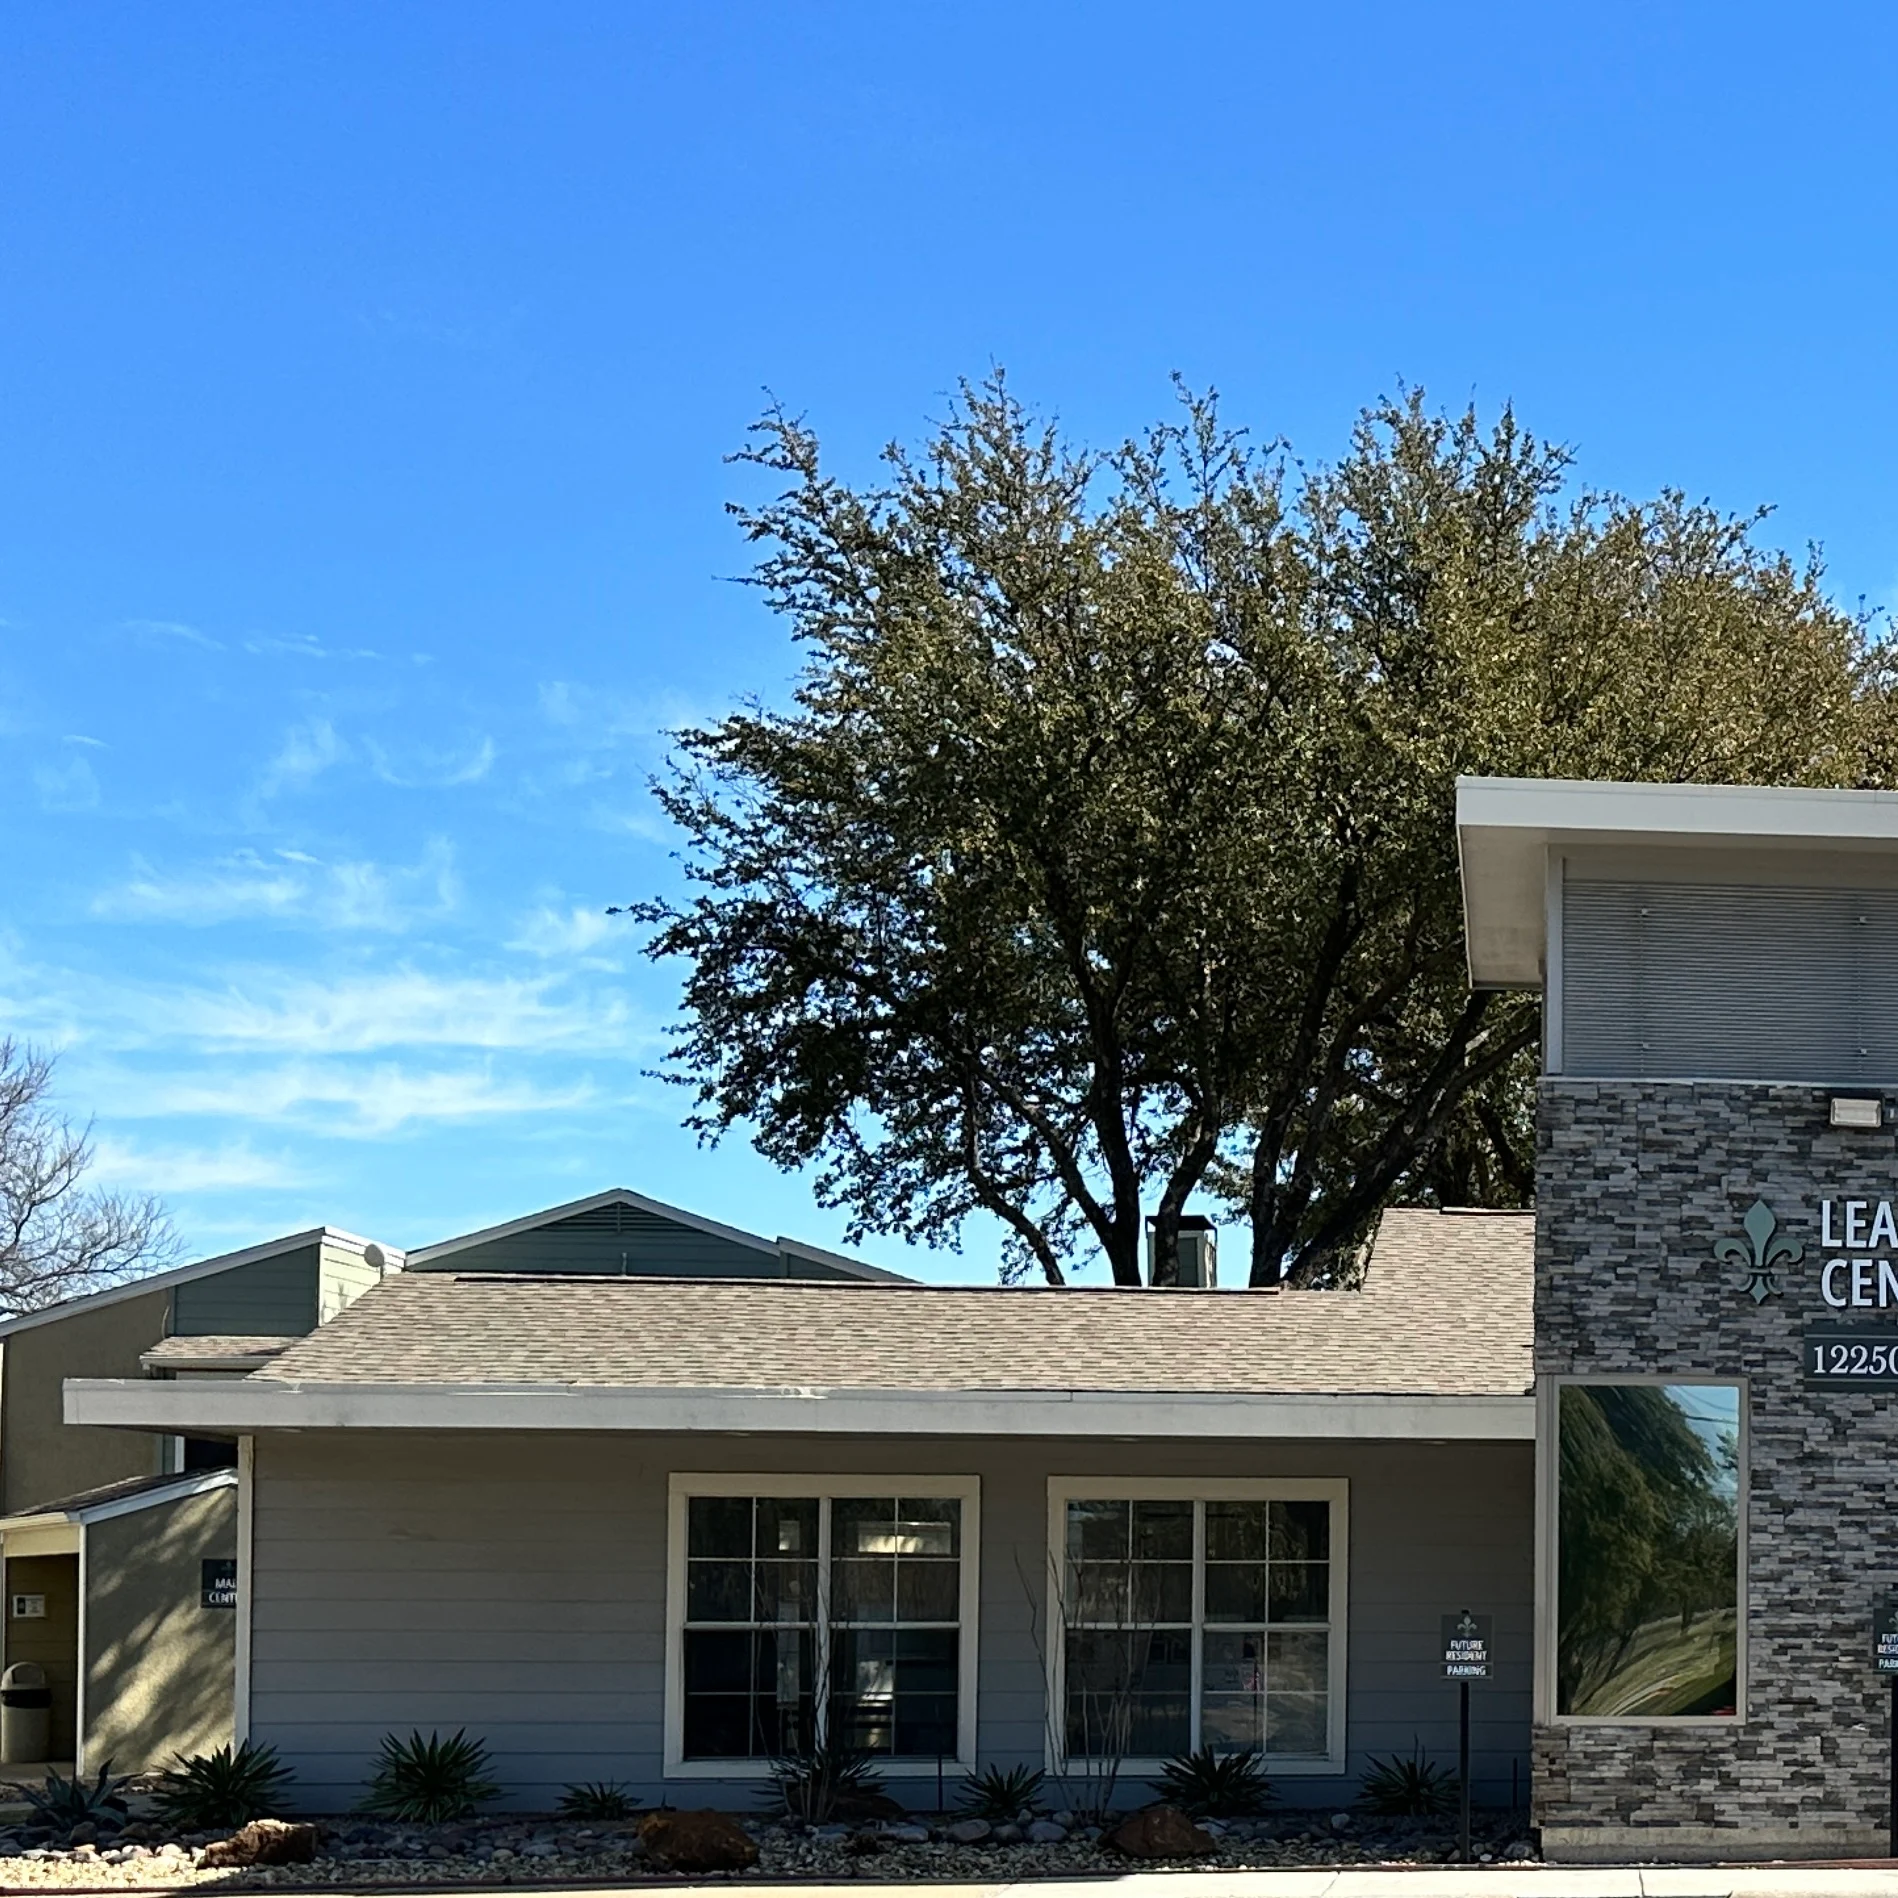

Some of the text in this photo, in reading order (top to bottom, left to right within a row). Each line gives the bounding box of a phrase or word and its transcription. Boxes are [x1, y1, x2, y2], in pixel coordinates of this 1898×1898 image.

[209, 1592, 237, 1603] CENT
[1451, 1640, 1484, 1650] FUTURE
[1446, 1650, 1487, 1660] RESIDENT
[1447, 1665, 1486, 1675] PARKING
